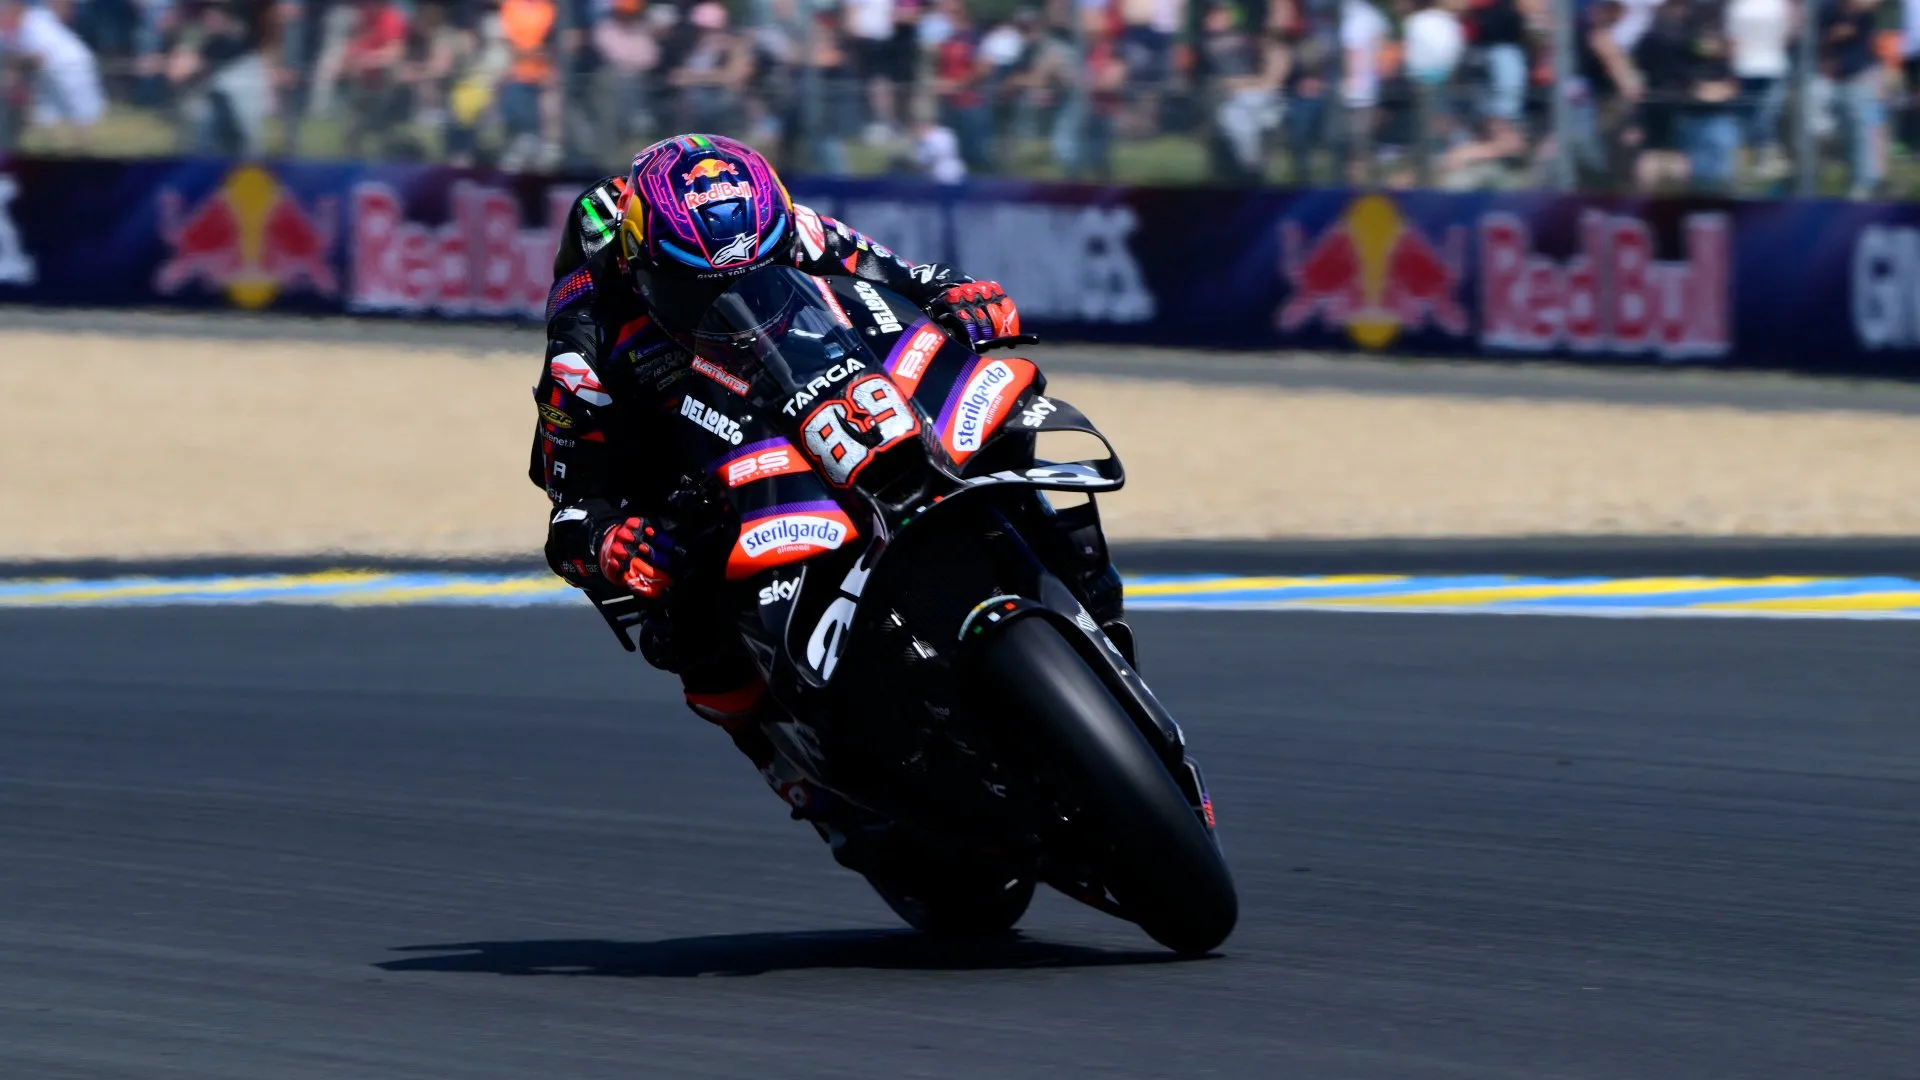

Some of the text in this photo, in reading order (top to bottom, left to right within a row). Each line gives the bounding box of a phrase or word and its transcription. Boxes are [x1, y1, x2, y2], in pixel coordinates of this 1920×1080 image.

[685, 181, 752, 209] Red Bull
[349, 181, 582, 316] Red Bu
[1476, 208, 1609, 351] Red
[1608, 209, 1735, 358] Bull
[895, 331, 938, 379] BS
[782, 357, 867, 417] TARGA
[960, 364, 1008, 447] sterilgarda
[801, 374, 920, 487] 89
[1022, 395, 1057, 428] sky
[728, 450, 790, 481] BS
[746, 520, 840, 550] sterilgarda
[777, 543, 811, 554] alimenti
[759, 576, 800, 606] sky
